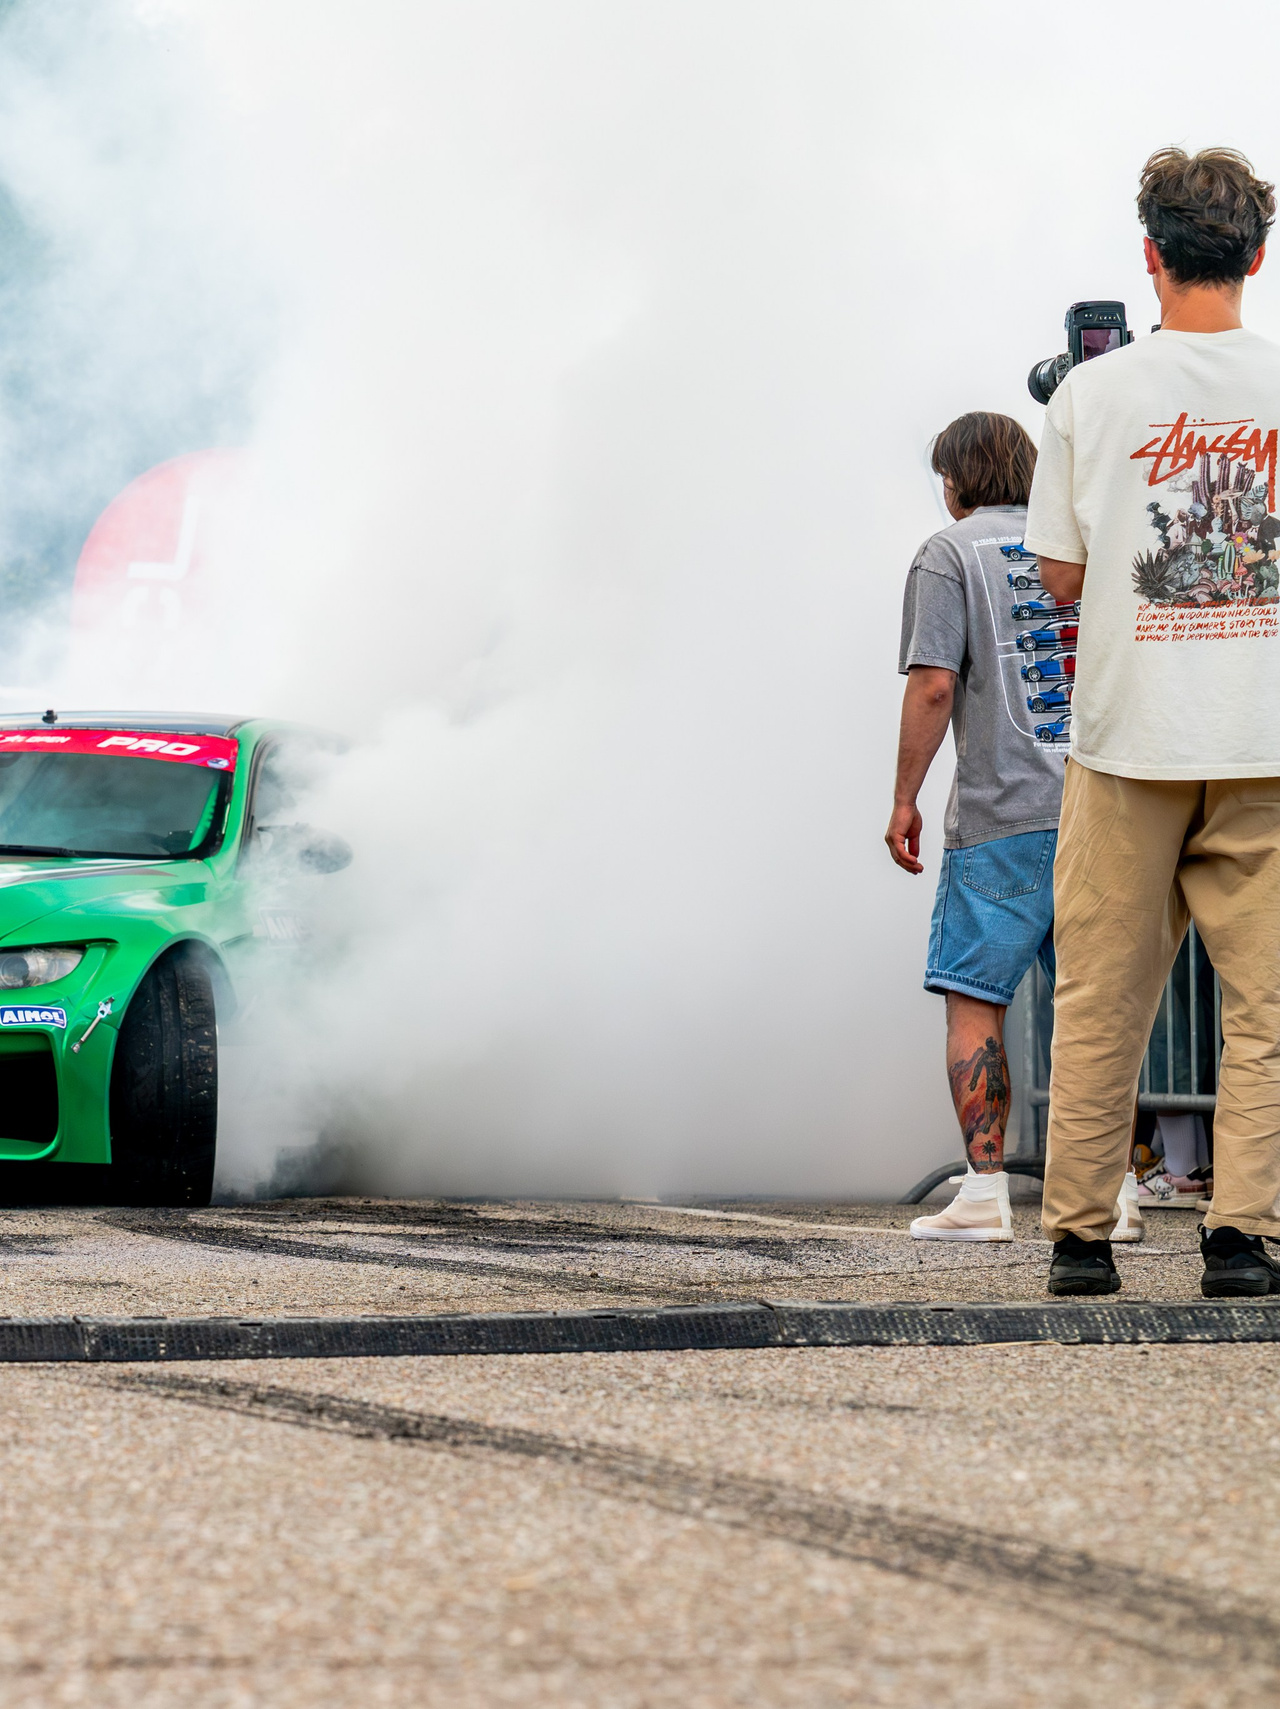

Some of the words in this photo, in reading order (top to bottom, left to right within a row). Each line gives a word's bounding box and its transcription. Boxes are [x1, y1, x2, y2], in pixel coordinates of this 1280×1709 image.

[1136, 611, 1175, 621] FLOWERS
[1211, 610, 1227, 619] AND
[1251, 607, 1277, 617] COULD
[1135, 623, 1156, 632] MAKE
[1156, 623, 1169, 632] ME
[1171, 622, 1189, 632] ANY
[1229, 618, 1257, 630] STORY
[1259, 617, 1280, 628] TELL
[1171, 633, 1185, 641] THE
[1186, 632, 1205, 641] DEEP
[1248, 630, 1261, 638] THE
[97, 736, 200, 756] PRO
[2, 1010, 65, 1025] AIMOL
